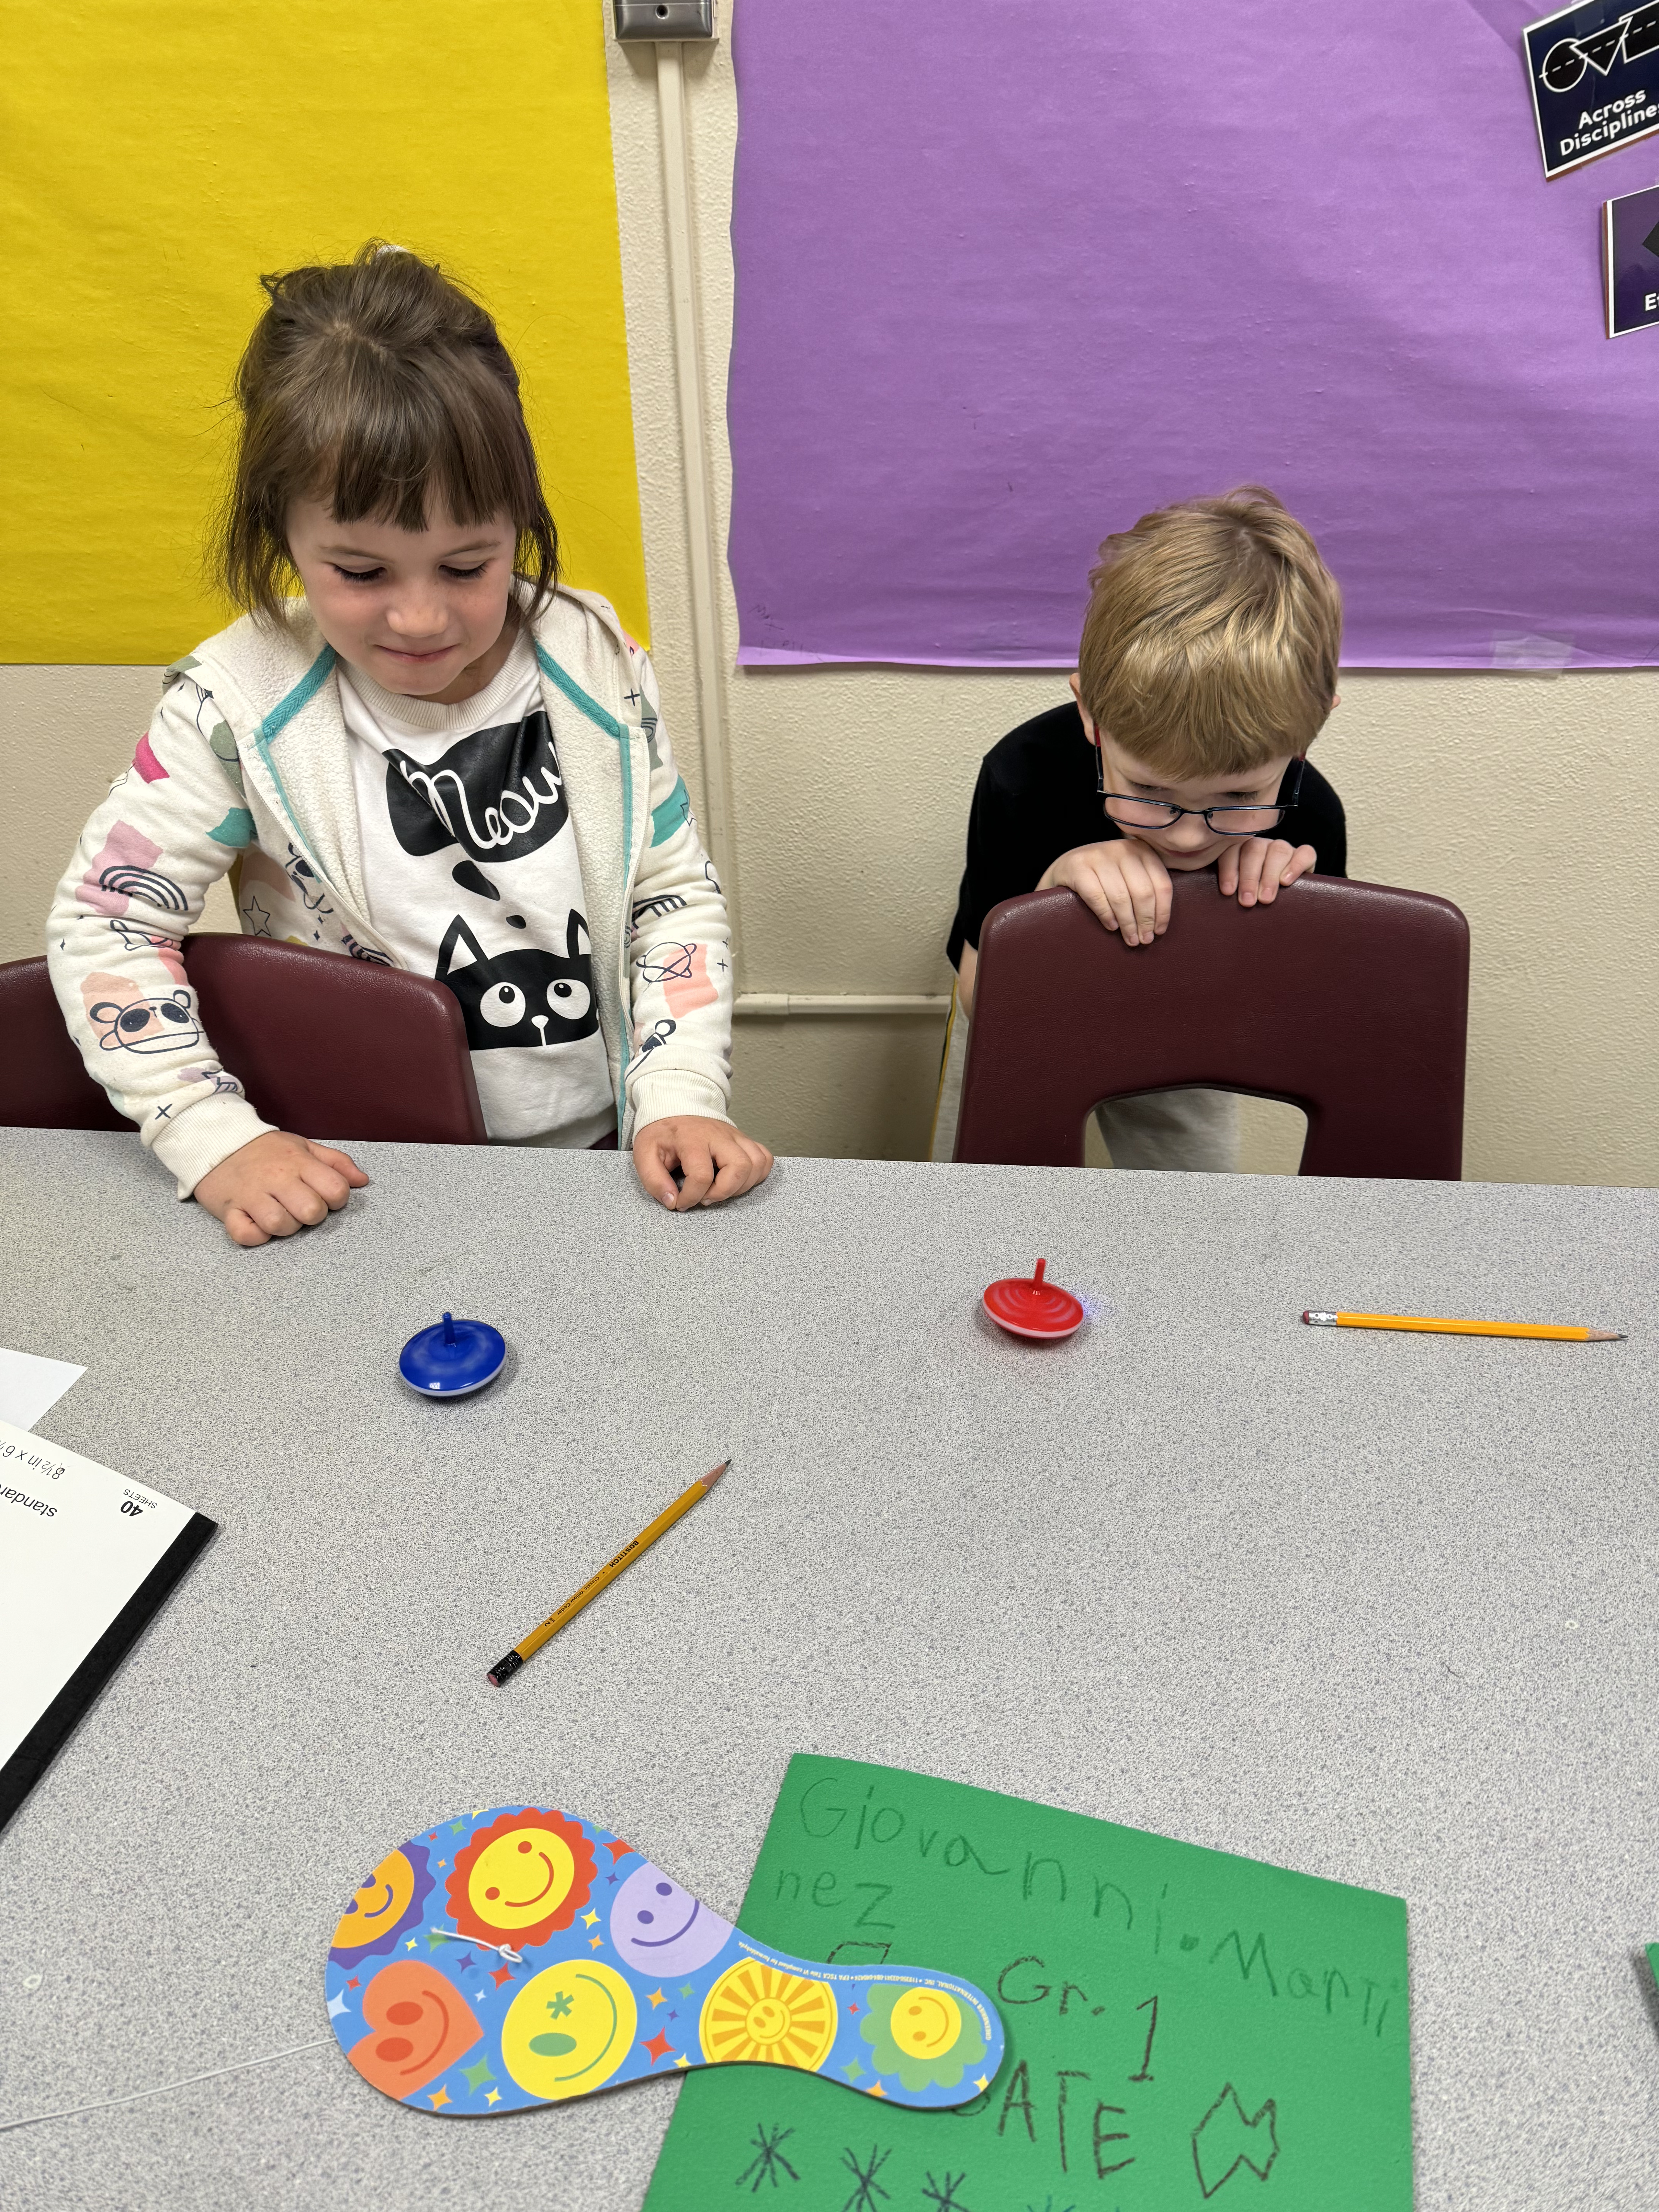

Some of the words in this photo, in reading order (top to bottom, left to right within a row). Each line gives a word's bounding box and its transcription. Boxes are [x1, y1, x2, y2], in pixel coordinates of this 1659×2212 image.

[1578, 89, 1646, 129] Across
[1560, 103, 1659, 156] Discipline
[400, 741, 562, 849] Meow
[15, 1450, 28, 1460] x
[27, 1455, 43, 1470] in
[0, 1484, 57, 1517] standar
[120, 1501, 143, 1517] 40
[123, 1488, 158, 1509] SHEETS
[609, 1540, 639, 1568] BOSTITCH
[584, 1576, 599, 1590] Classic
[570, 1590, 585, 1603] Yellow
[557, 1602, 571, 1615] Cedar
[949, 2060, 1137, 2179] ATE
